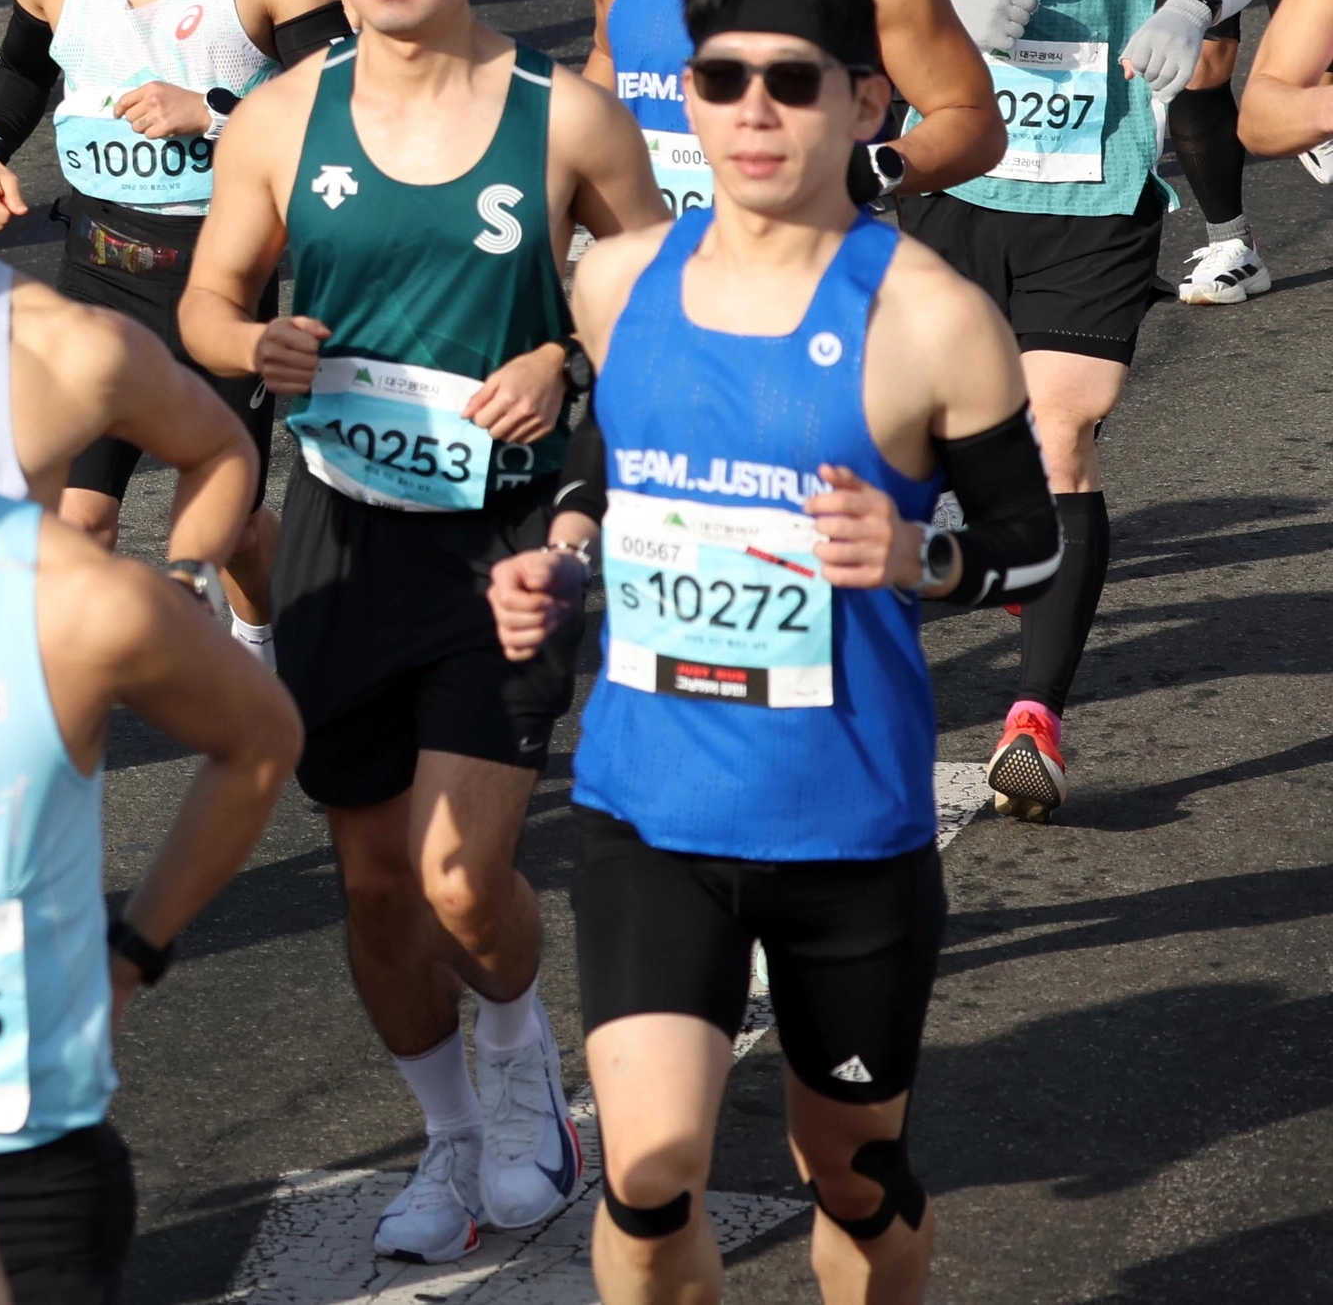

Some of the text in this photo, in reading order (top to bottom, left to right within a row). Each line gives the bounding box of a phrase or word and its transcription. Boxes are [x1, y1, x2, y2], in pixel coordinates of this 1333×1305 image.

[1019, 50, 1064, 61] 대구광역시
[995, 89, 1095, 130] 0297
[66, 136, 214, 178] S 10009
[384, 375, 441, 396] 대구광역시
[326, 419, 473, 484] 10253
[621, 535, 682, 563] 00567
[621, 570, 810, 632] S 10272
